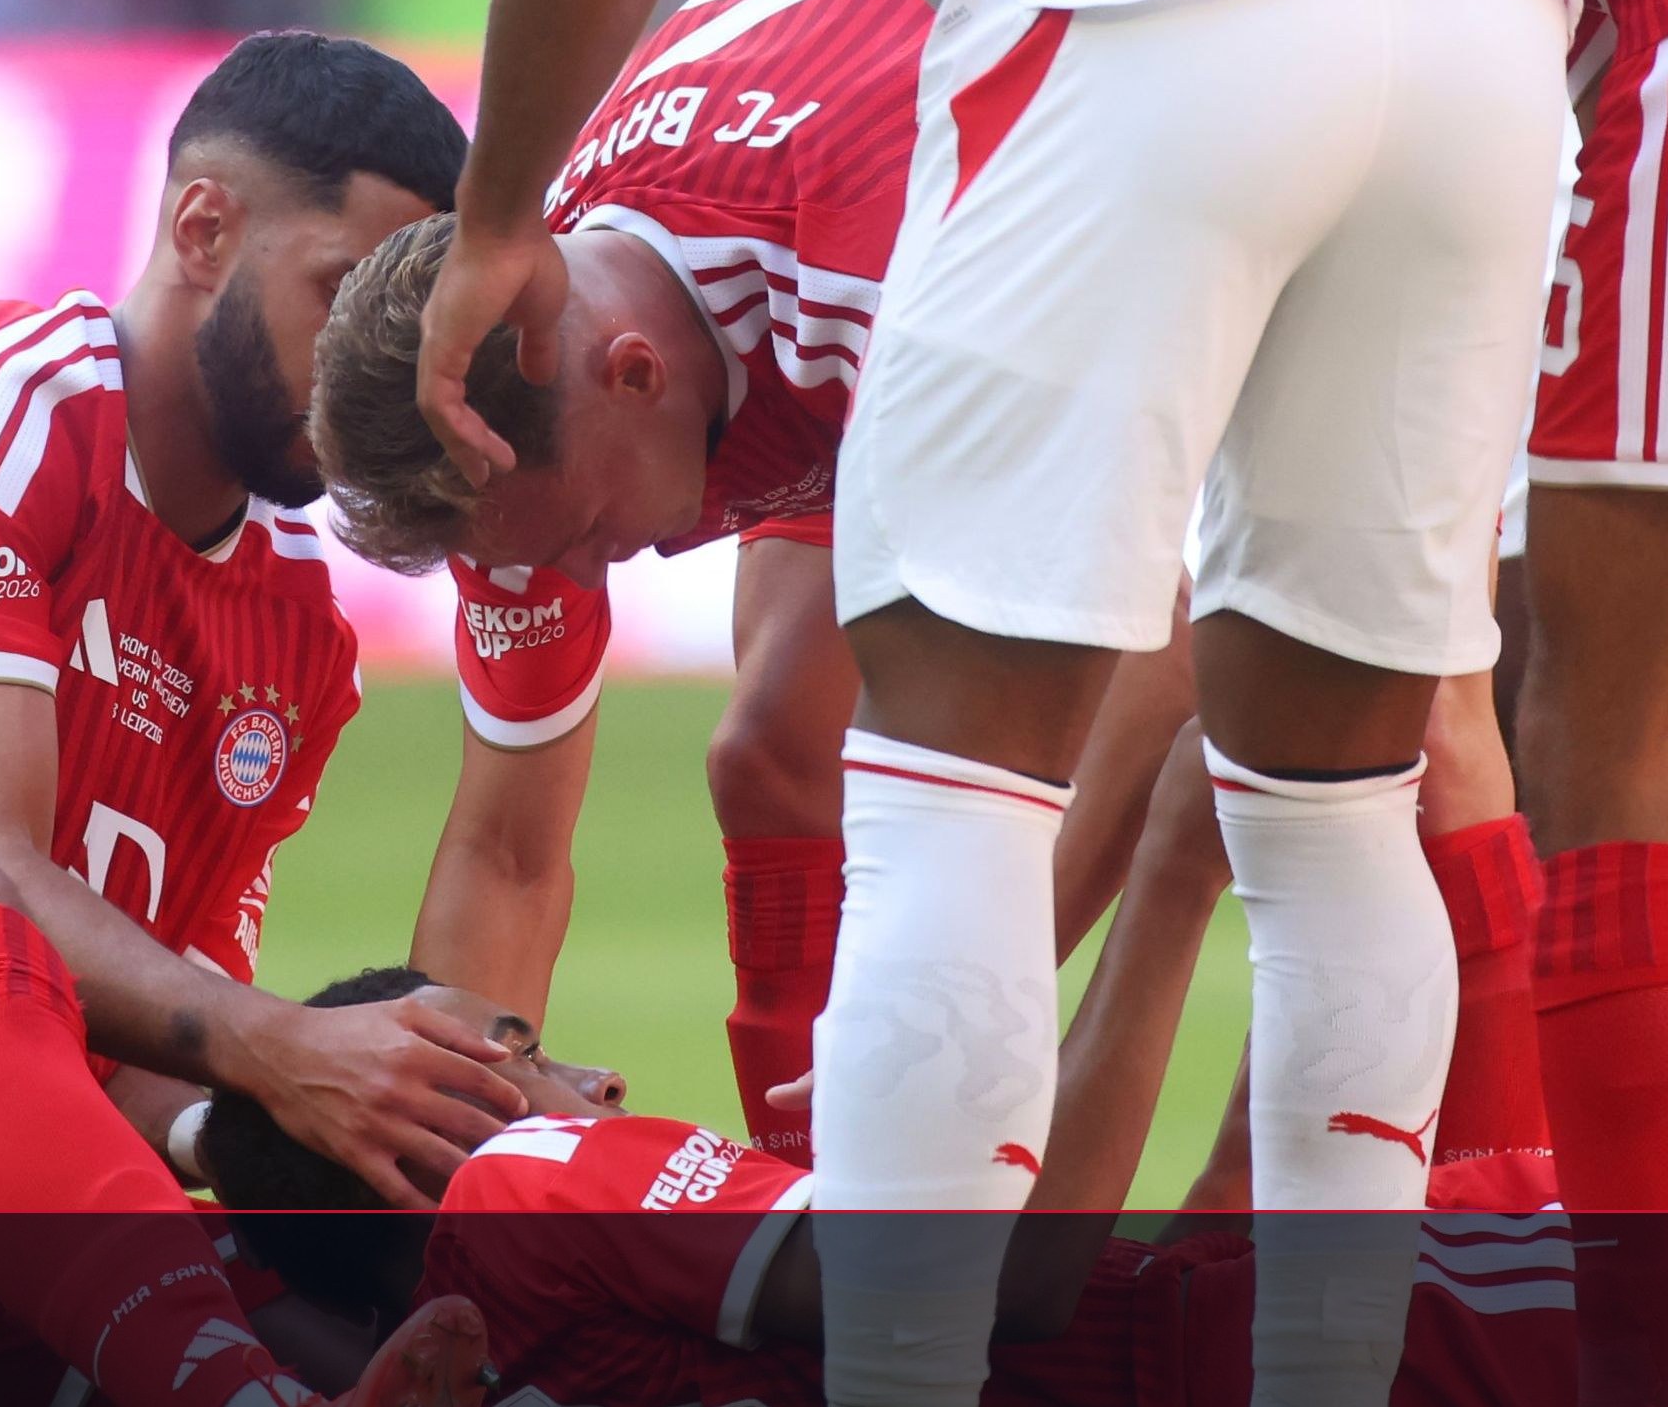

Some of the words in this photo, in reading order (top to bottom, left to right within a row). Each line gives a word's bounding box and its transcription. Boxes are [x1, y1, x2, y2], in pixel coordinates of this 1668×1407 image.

[714, 90, 821, 149] FC
[513, 621, 566, 649] 2026
[162, 664, 194, 695] 2026
[230, 720, 248, 741] FC
[251, 716, 281, 764] BAYERN
[112, 1285, 151, 1324] MIA
[159, 1263, 208, 1287] SAN
